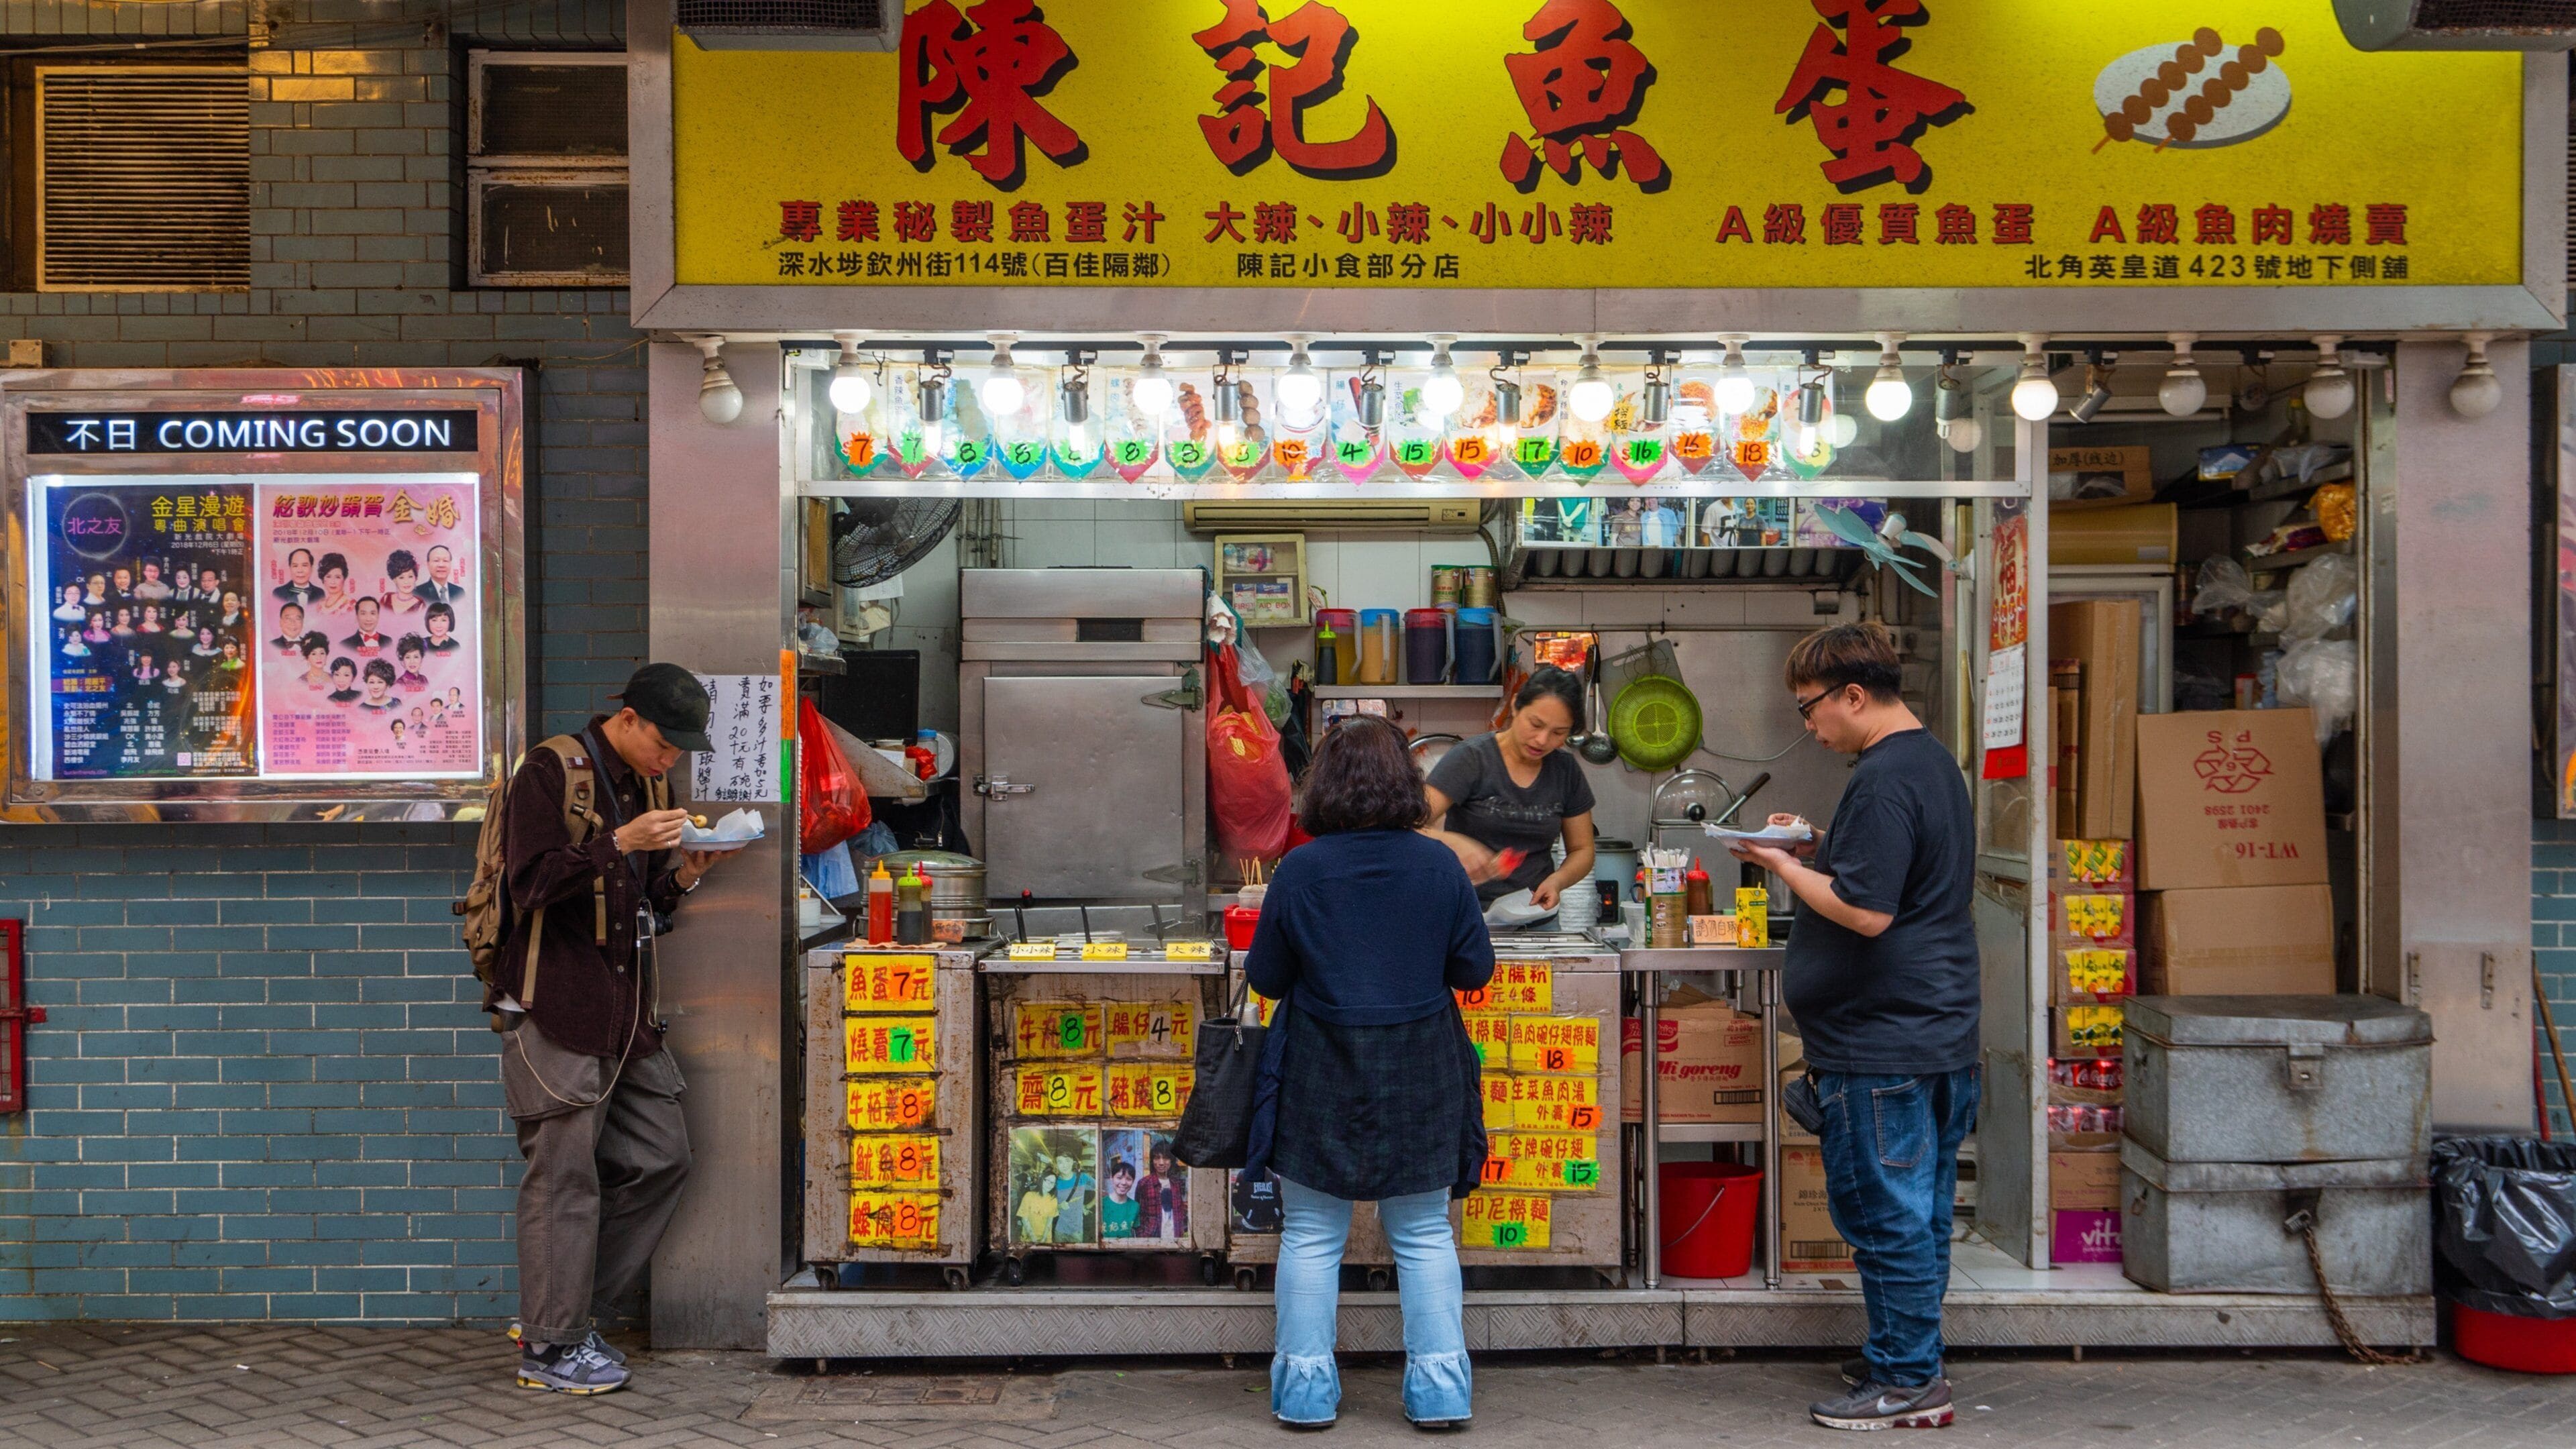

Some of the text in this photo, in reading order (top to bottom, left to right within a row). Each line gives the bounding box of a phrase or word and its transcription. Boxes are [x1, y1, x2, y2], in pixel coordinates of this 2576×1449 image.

[897, 0, 1976, 195] 陳記魚蛋
[780, 201, 1165, 244] 專業秘製魚蛋汁
[1203, 201, 1613, 245] 大辣、小辣、小小辣
[1717, 203, 2035, 246] A級優質魚蛋
[2090, 203, 2408, 246] A級魚肉燒賣
[1236, 252, 1460, 279] 陳記小食部分店
[66, 418, 451, 450] 不日 COMING SOON
[854, 438, 870, 462] 7
[959, 443, 977, 463] 8
[1014, 443, 1031, 464] 8
[1124, 443, 1140, 462] 8
[1342, 443, 1363, 462] 4
[1405, 443, 1424, 460] 15
[1458, 440, 1481, 459] 15
[1521, 441, 1544, 460] 17
[1574, 445, 1593, 464] 10
[1635, 441, 1653, 460] 16
[1743, 443, 1763, 462] 18
[150, 495, 246, 517] 金星漫遊
[68, 517, 122, 535] 北之友
[154, 518, 246, 533] 粵曲演唱會
[2235, 842, 2300, 859] WT-16
[1012, 945, 1051, 954] 小小辣
[1086, 945, 1121, 954] 小辣
[1173, 945, 1206, 954] 大辣
[1546, 1049, 1564, 1069] 18
[1678, 1064, 1743, 1079] goreng
[1571, 1108, 1593, 1126] 15
[1485, 1161, 1505, 1181] 17
[1572, 1163, 1591, 1183] 15
[1499, 1226, 1518, 1245] 10
